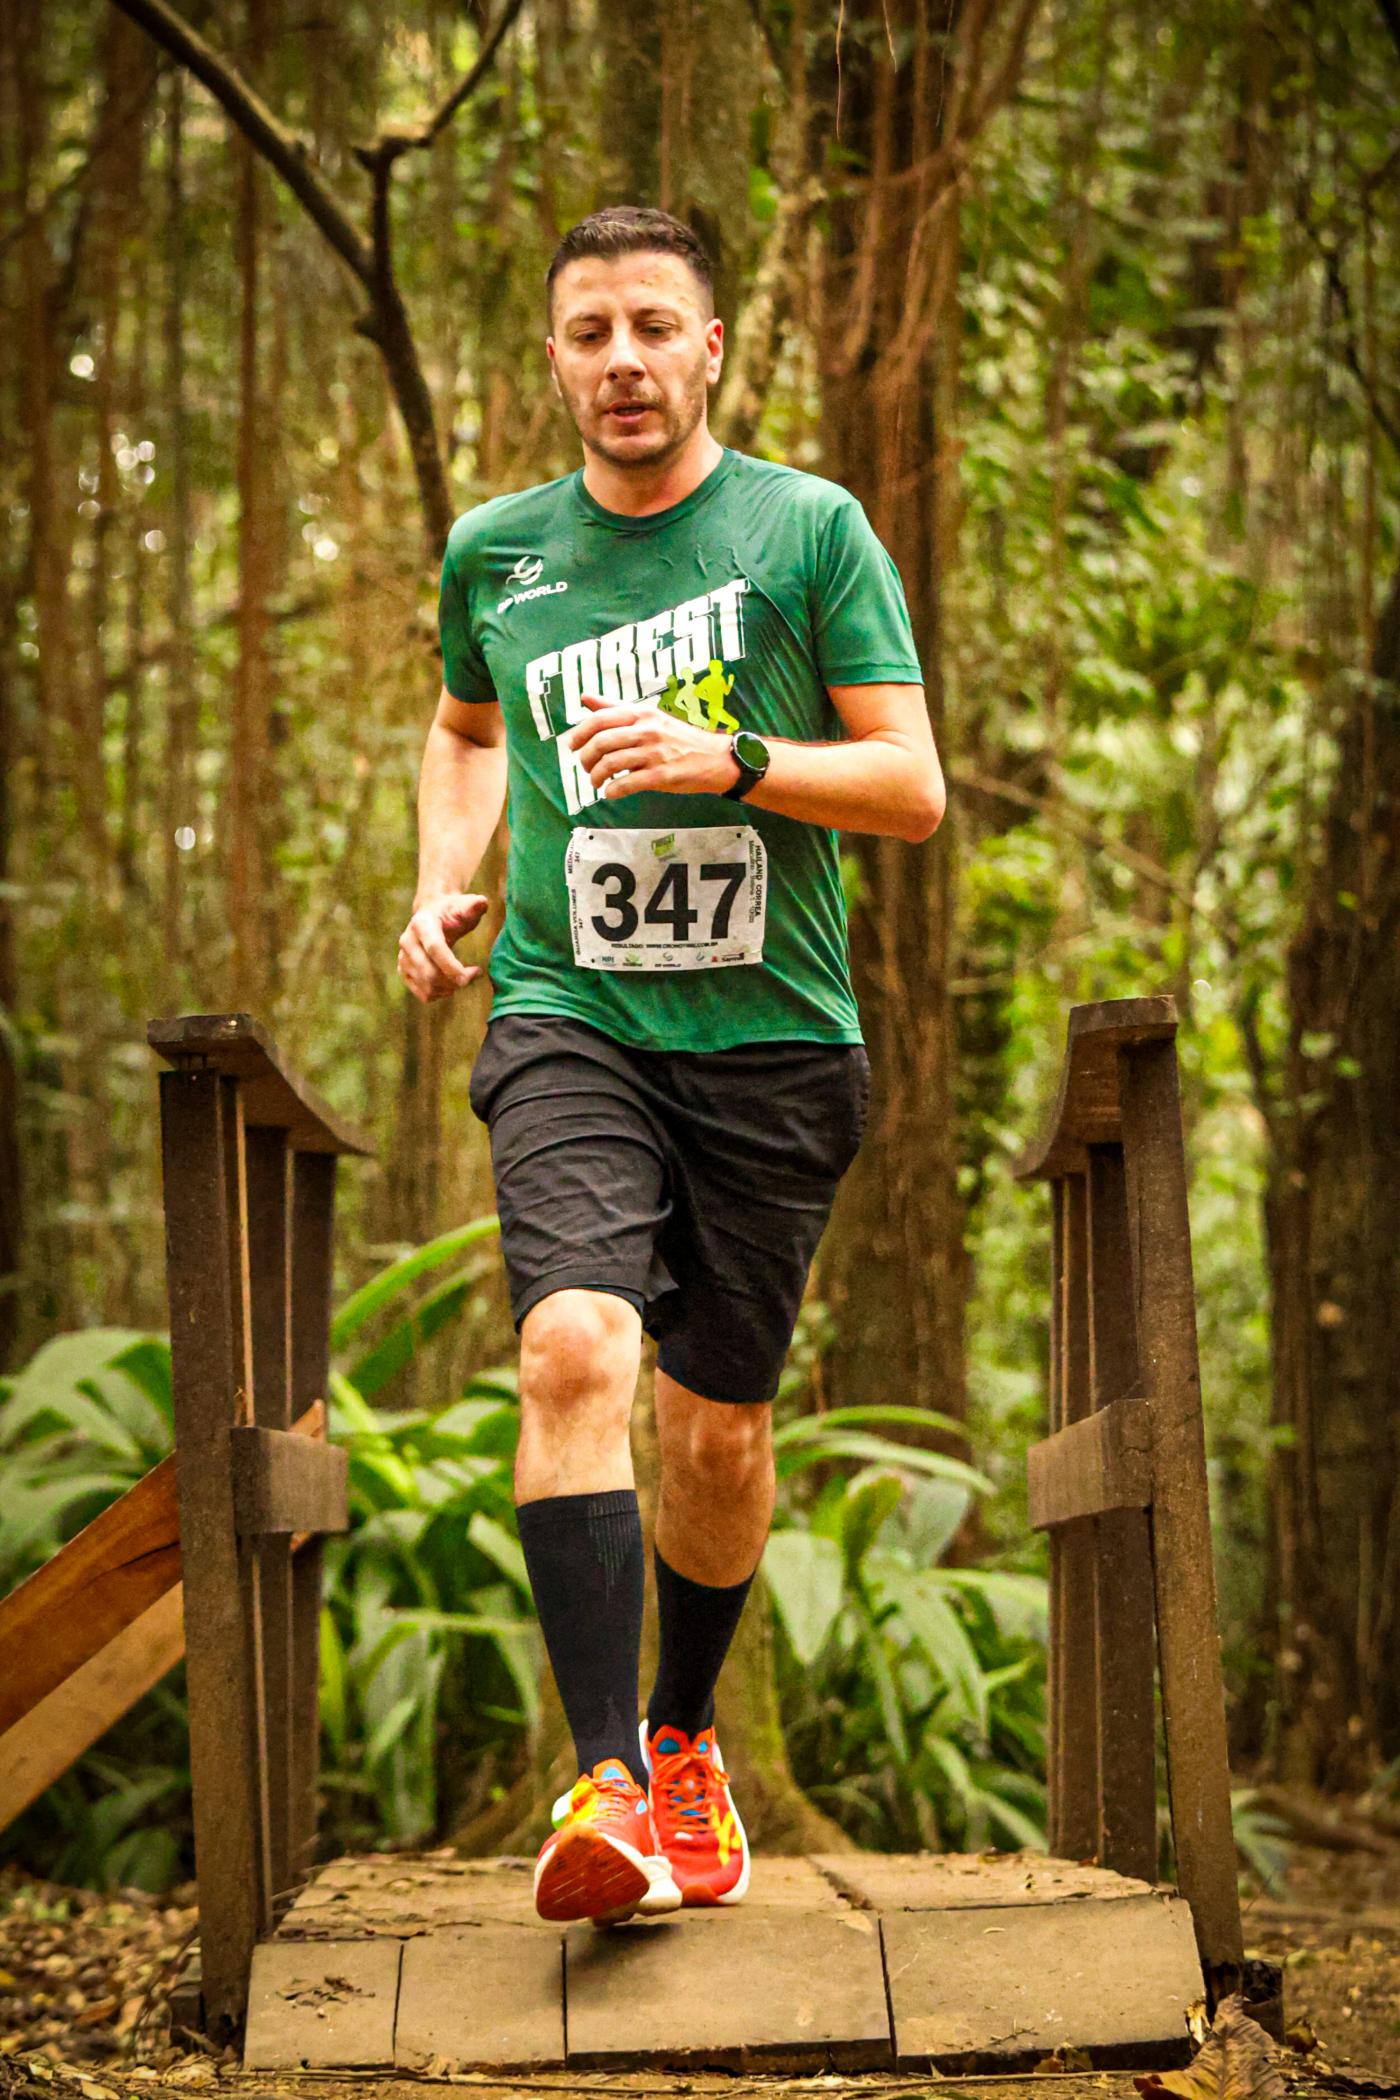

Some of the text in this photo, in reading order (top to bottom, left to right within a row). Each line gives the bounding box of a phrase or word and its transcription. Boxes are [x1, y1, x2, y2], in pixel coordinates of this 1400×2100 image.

[513, 581, 568, 605] WORLD
[526, 577, 750, 741] FOREST
[591, 862, 746, 942] 347
